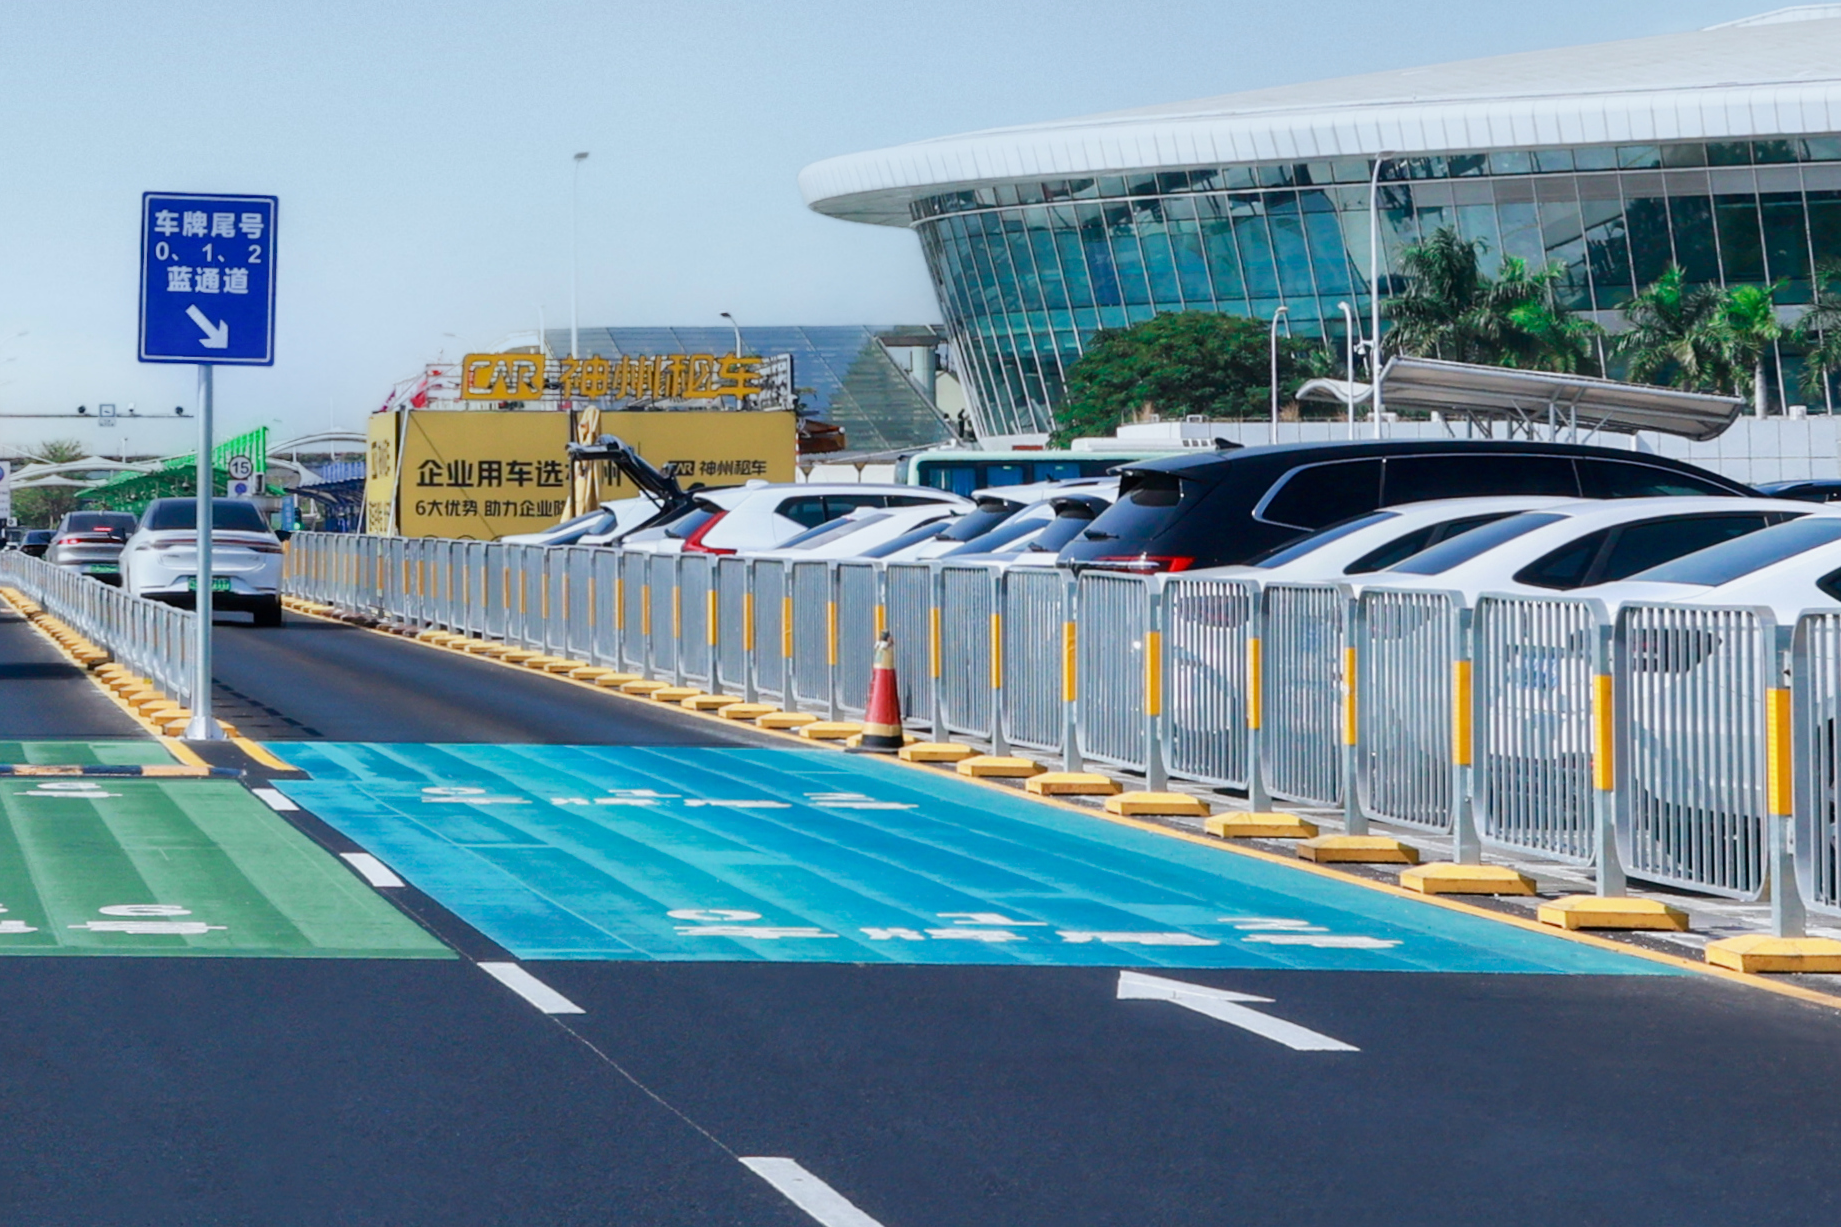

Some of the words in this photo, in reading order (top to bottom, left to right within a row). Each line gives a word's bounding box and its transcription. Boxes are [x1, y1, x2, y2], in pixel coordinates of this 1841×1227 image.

[154, 209, 264, 239] 车牌尾号
[166, 265, 249, 294] 蓝通道
[465, 357, 543, 397] CAR
[559, 354, 764, 400] 神州租车
[232, 461, 250, 474] 15
[416, 459, 621, 488] 企业用车选州
[700, 460, 767, 476] 神州租车
[415, 499, 478, 517] 6大优势
[98, 904, 193, 917] 6
[665, 909, 764, 922] 0
[935, 912, 1049, 927] 1
[1216, 917, 1330, 932] 2
